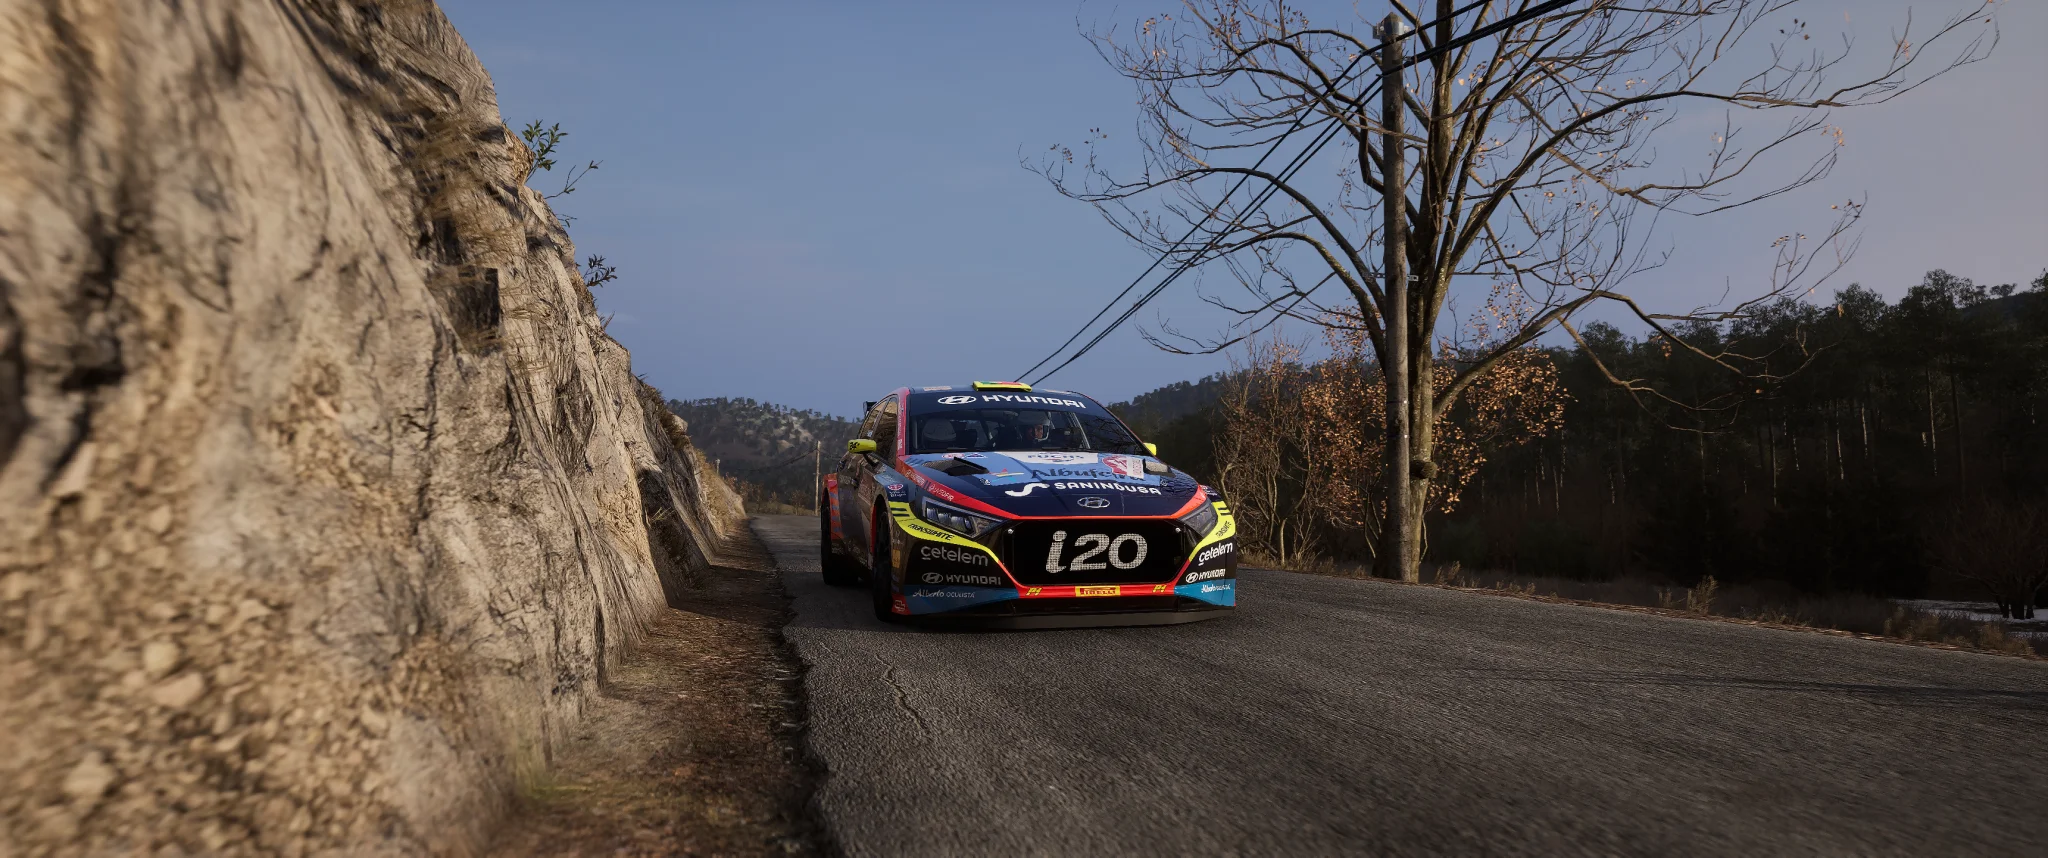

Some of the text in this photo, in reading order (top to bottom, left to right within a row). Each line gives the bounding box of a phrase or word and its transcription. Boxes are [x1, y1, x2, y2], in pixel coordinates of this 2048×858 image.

[982, 395, 1086, 408] HYUNDAI
[1031, 467, 1145, 482] Albufe
[1053, 482, 1162, 496] SANINDUSA
[920, 545, 989, 567] cetelem
[1045, 530, 1148, 574] i20
[945, 574, 1002, 586] HYUNDAI
[1198, 569, 1226, 581] HYUNDAI
